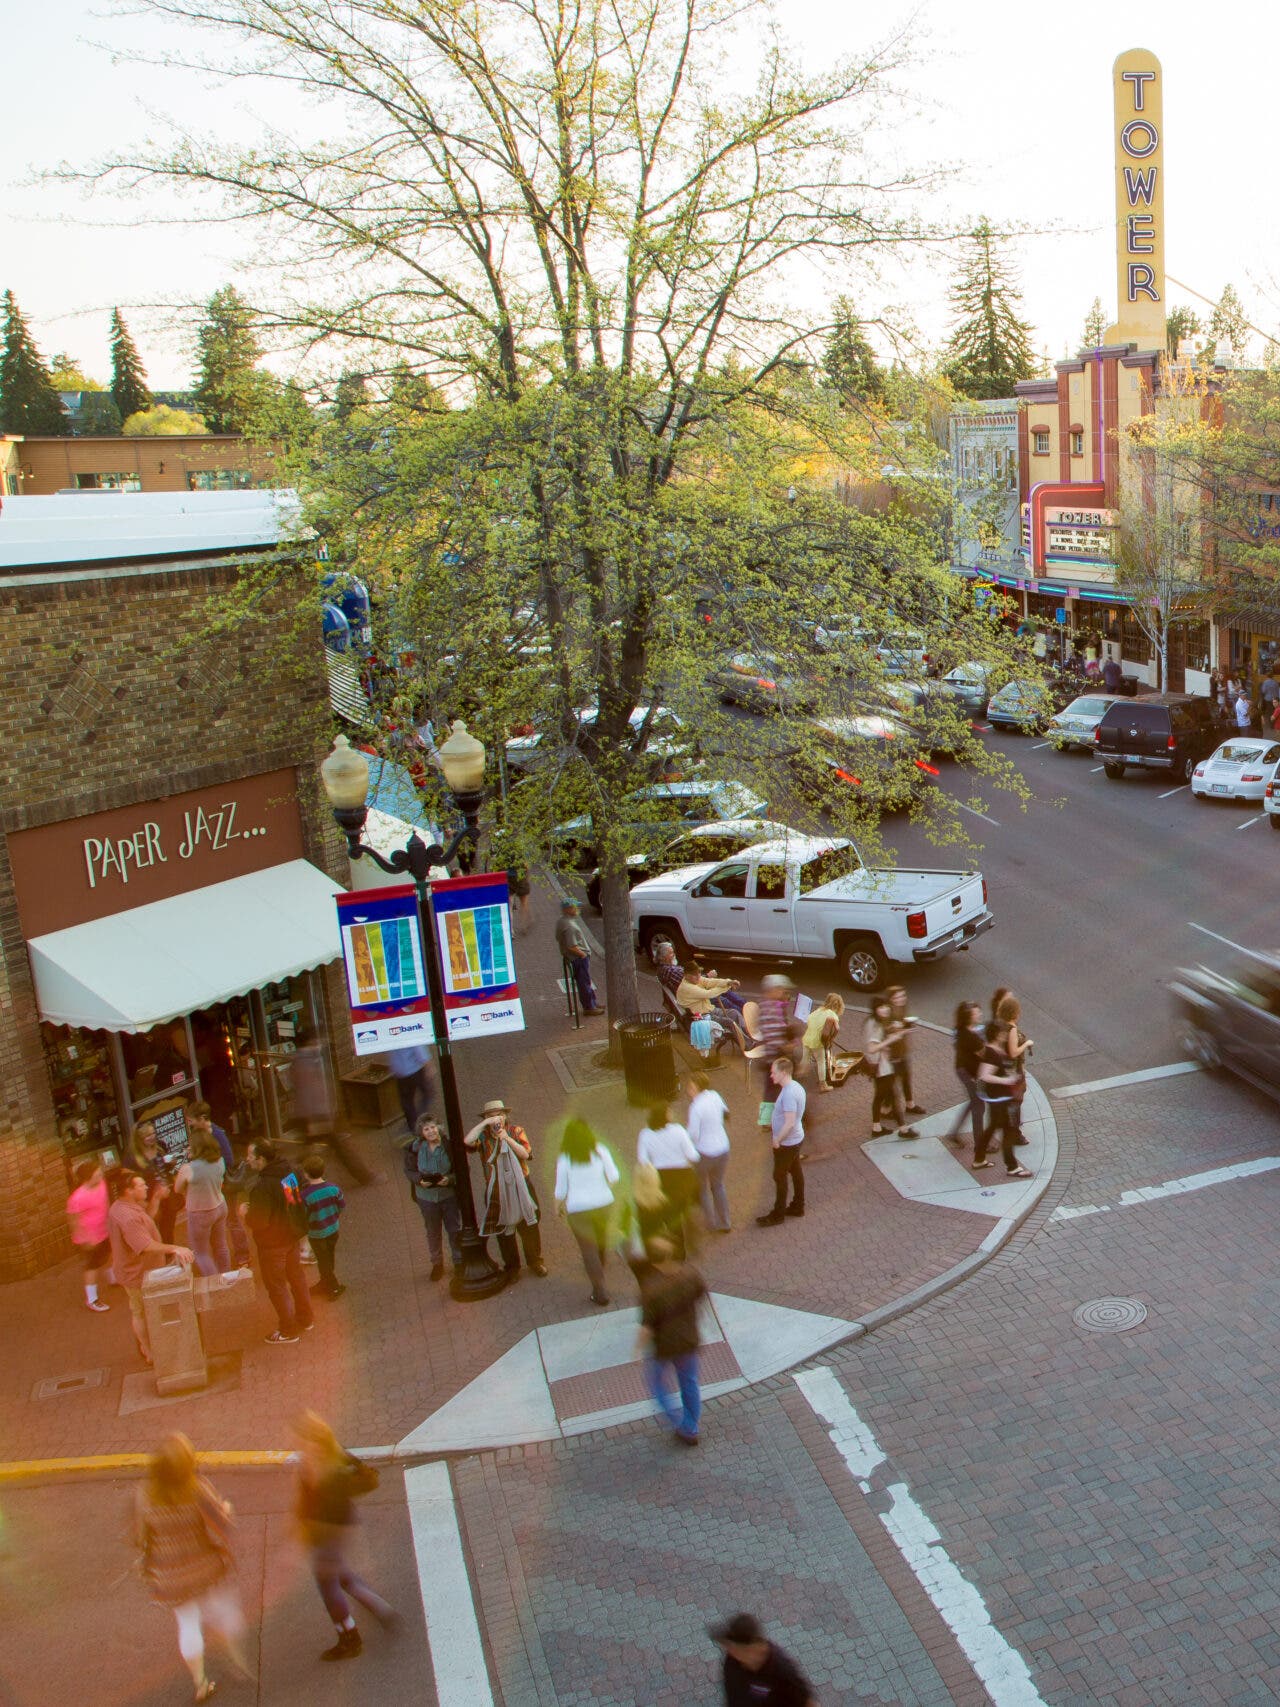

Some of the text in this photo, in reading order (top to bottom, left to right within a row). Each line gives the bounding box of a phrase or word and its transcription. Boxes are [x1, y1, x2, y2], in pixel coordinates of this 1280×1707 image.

[1121, 71, 1160, 302] TOWER
[1056, 511, 1102, 525] TOWER
[84, 801, 267, 888] PAPER JAZZ...
[156, 1109, 183, 1128] ALWAYS BE
[156, 1117, 184, 1133] YOURSELF
